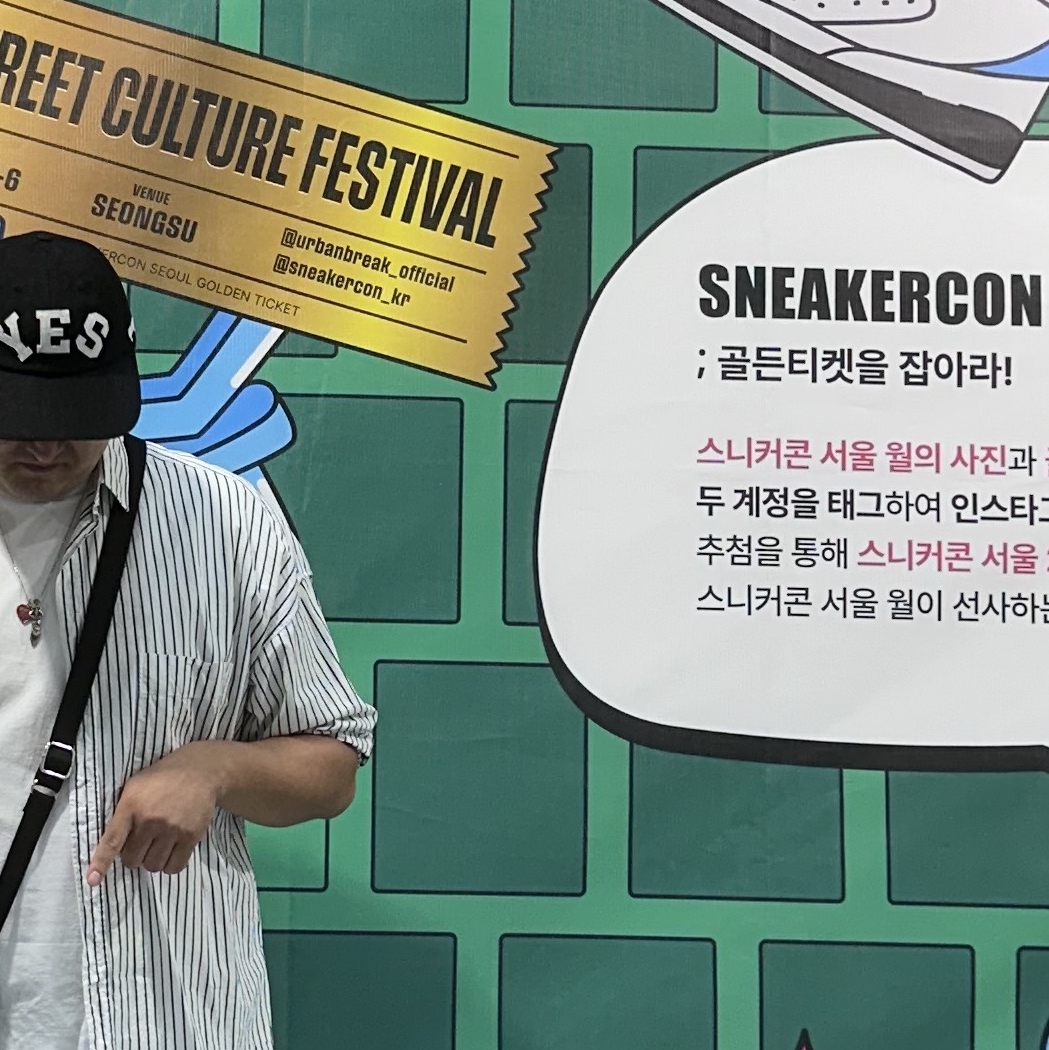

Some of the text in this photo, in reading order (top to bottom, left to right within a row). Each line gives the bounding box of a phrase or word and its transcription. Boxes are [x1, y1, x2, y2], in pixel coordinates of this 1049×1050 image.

[101, 66, 305, 187] CULTURE
[298, 123, 505, 250] FESTIVAL
[132, 183, 171, 206] VENUE
[90, 193, 199, 244] SEONGSU
[102, 248, 301, 316] ERCON SEOUL GOLDEN TICKET
[272, 253, 411, 307] @sneakercon_kr
[280, 227, 456, 293] @urbanbreak_official
[698, 263, 1042, 328] SNEAKERCON
[717, 345, 889, 386] 골든티켓을
[898, 350, 1013, 389] 잡아라!
[696, 436, 813, 470] 스니커콘
[819, 440, 878, 472] 서울
[884, 441, 941, 474] 월의
[949, 444, 1038, 477] 사진과
[696, 485, 726, 517] 두
[732, 485, 820, 520] 계정을
[827, 489, 941, 524] 태그하여
[696, 533, 784, 568] 추첨을
[790, 536, 848, 570] 통해
[857, 539, 974, 573] 스니커콘
[981, 542, 1039, 575] 서울
[696, 584, 813, 618] 스니커콘
[820, 587, 879, 620] 서울
[886, 589, 943, 622] 월이
